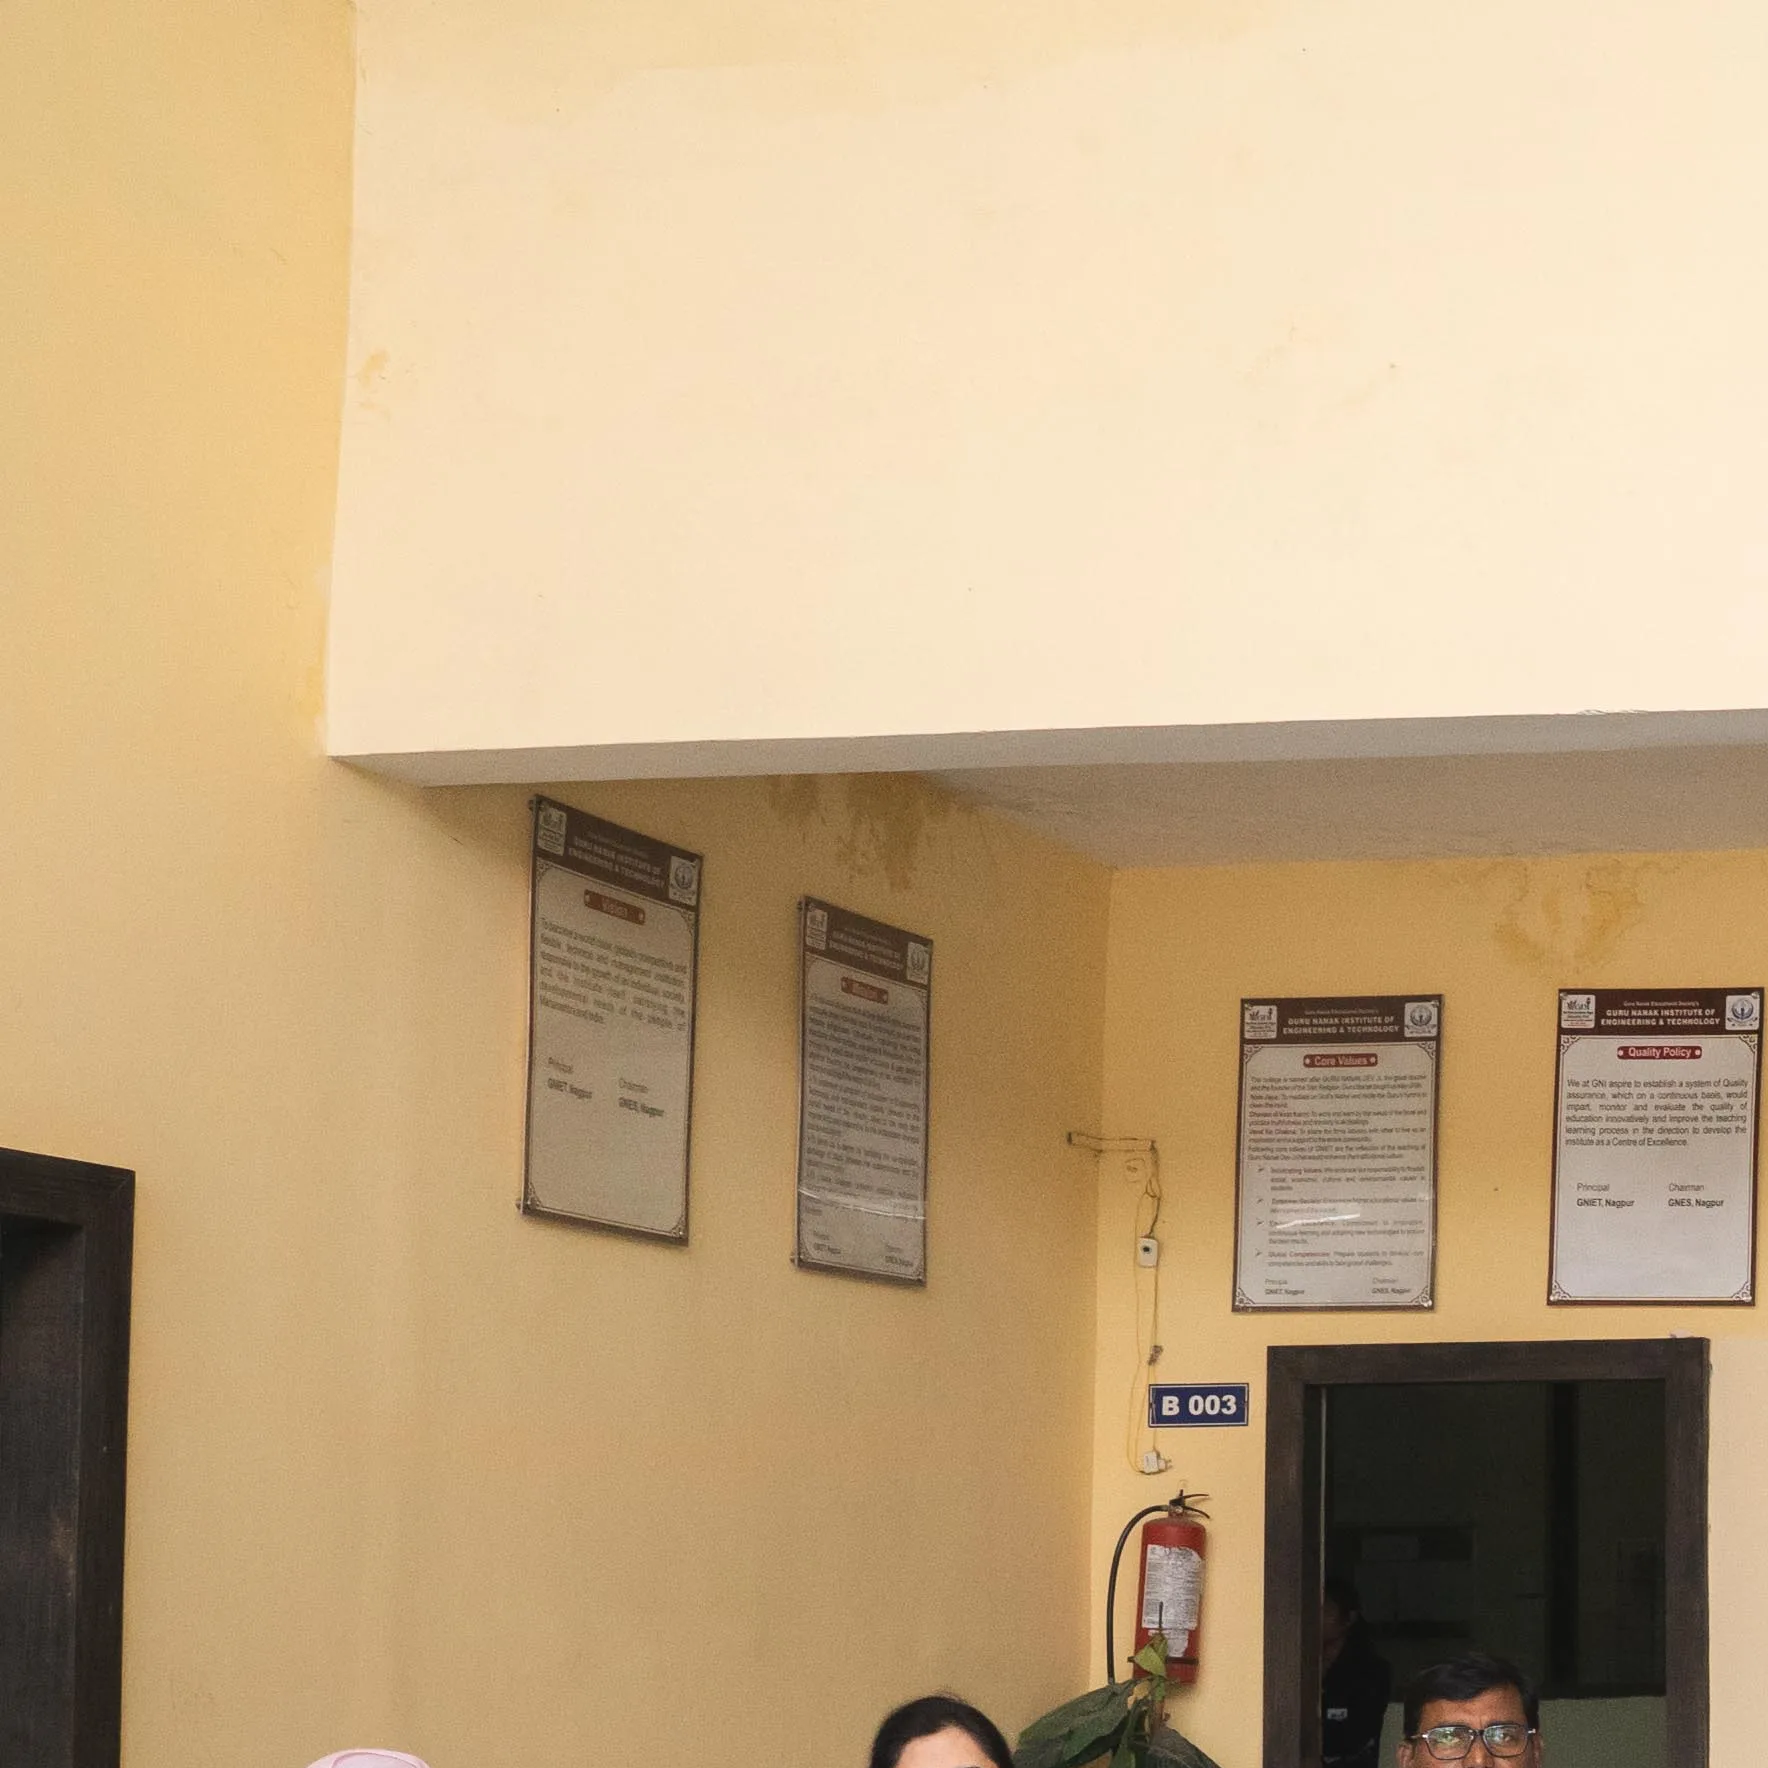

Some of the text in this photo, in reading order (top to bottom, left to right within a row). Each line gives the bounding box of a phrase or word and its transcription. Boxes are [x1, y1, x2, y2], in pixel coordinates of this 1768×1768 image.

[1606, 1009, 1716, 1017] GURU NANAK INSTITUTE OF
[1600, 1018, 1721, 1026] ENGINEERING TECHNOLOGY
[1628, 1047, 1692, 1059] Quality Policy
[1314, 1054, 1369, 1066] Core Values
[1685, 1080, 1712, 1089] system
[1722, 1078, 1748, 1088] Quality
[1599, 1127, 1628, 1136] process
[1703, 1126, 1732, 1136] develop
[1576, 1182, 1610, 1192] Principal
[1668, 1183, 1705, 1192] Chairman
[1605, 1199, 1634, 1209] Nagpur
[1695, 1199, 1724, 1209] Nagpur
[1162, 1394, 1237, 1415] B 003
